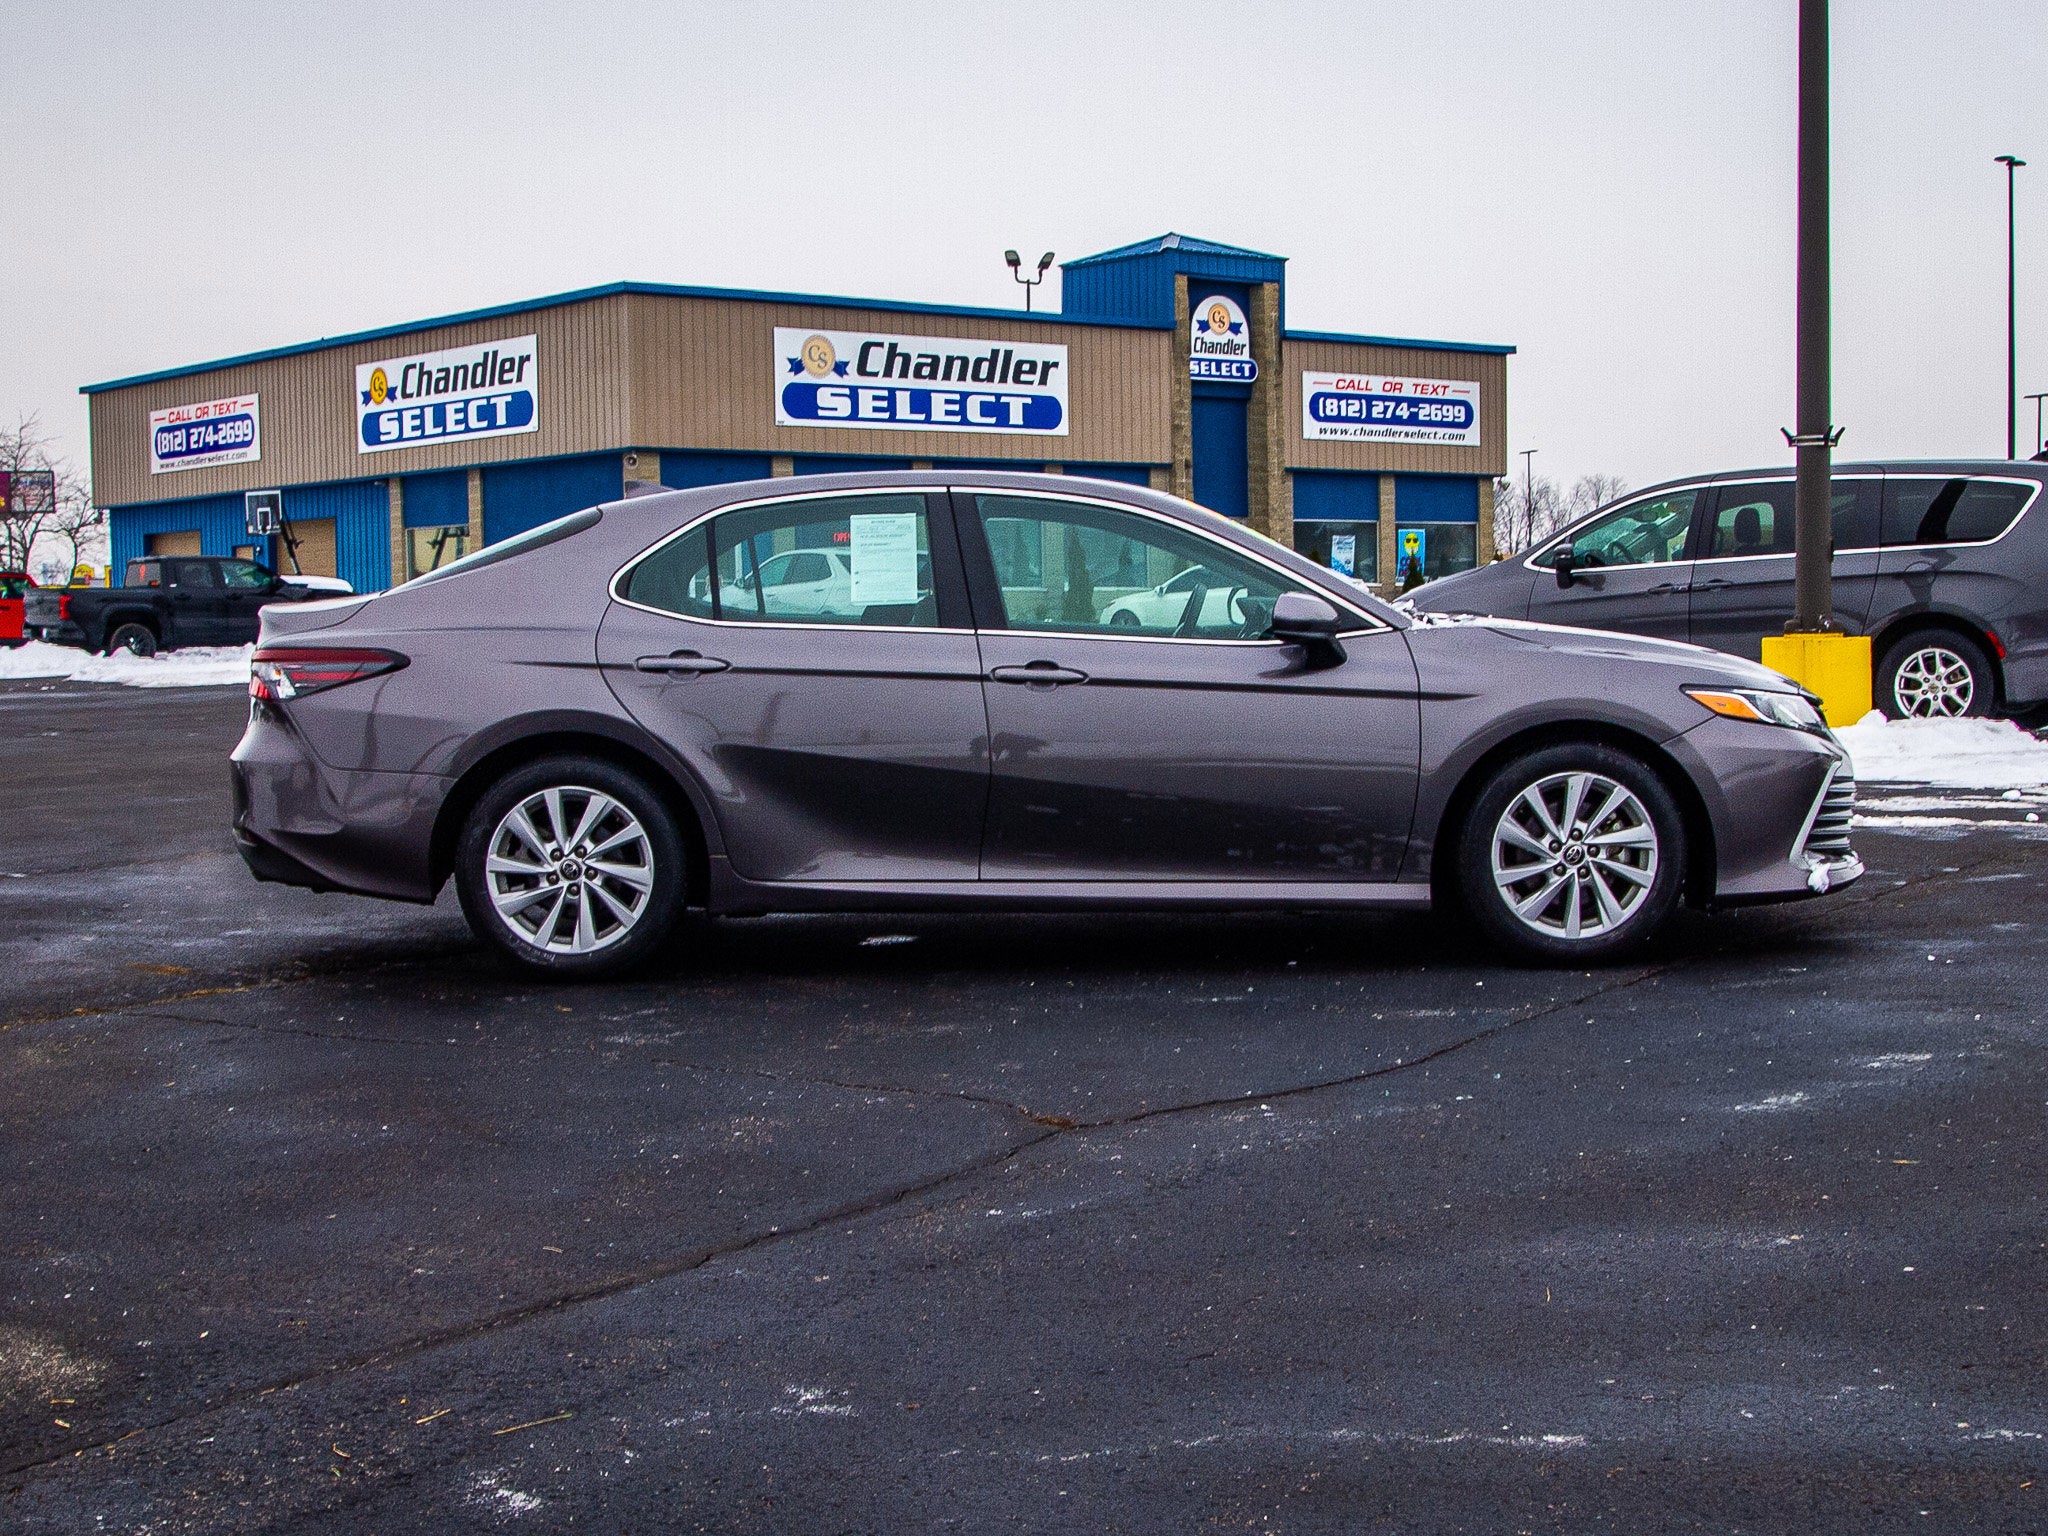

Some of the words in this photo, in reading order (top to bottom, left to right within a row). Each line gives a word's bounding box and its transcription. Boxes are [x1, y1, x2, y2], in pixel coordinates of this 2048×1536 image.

[1193, 336, 1247, 356] Chandler
[400, 349, 531, 400] Chandler
[856, 340, 1060, 387] Chandler
[1189, 360, 1252, 377] SELECT
[1335, 379, 1373, 391] CALL
[1382, 381, 1404, 394] OR
[1412, 383, 1450, 396] TEXT
[168, 409, 192, 423] CALL
[195, 405, 210, 419] OR
[212, 400, 238, 415] TEXT
[378, 395, 513, 442] SELECT
[816, 386, 1033, 426] SELECT
[1318, 397, 1367, 420] (812)
[1371, 400, 1466, 423] 274-2699
[157, 428, 187, 456] (812)
[189, 419, 253, 450] 274-2699
[1319, 425, 1466, 442] www.chandlerselect.com
